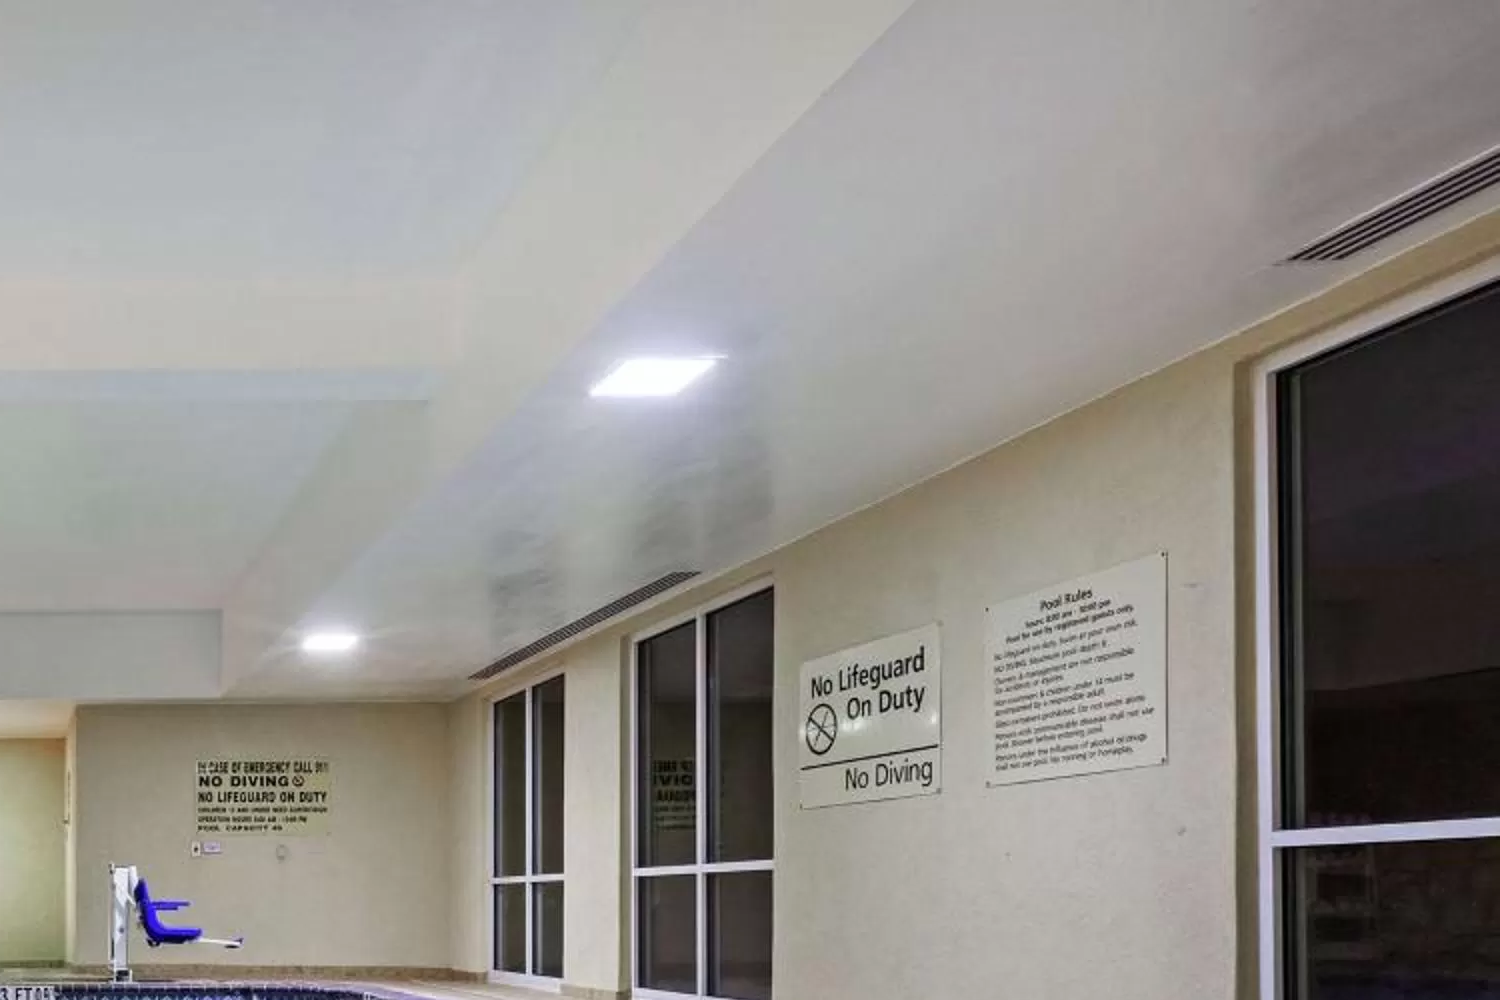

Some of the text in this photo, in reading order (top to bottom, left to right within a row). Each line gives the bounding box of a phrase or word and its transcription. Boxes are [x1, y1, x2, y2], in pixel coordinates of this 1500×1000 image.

[1040, 589, 1092, 611] Pool Rules
[811, 645, 925, 698] No Lifeguard
[847, 685, 925, 720] On Duty
[243, 761, 290, 773] EMERGENCY
[293, 761, 312, 773] CALL
[846, 758, 933, 790] No Diving
[199, 776, 289, 787] NO DIVING
[198, 792, 327, 803] NO LIFEGUARD ON DUTY
